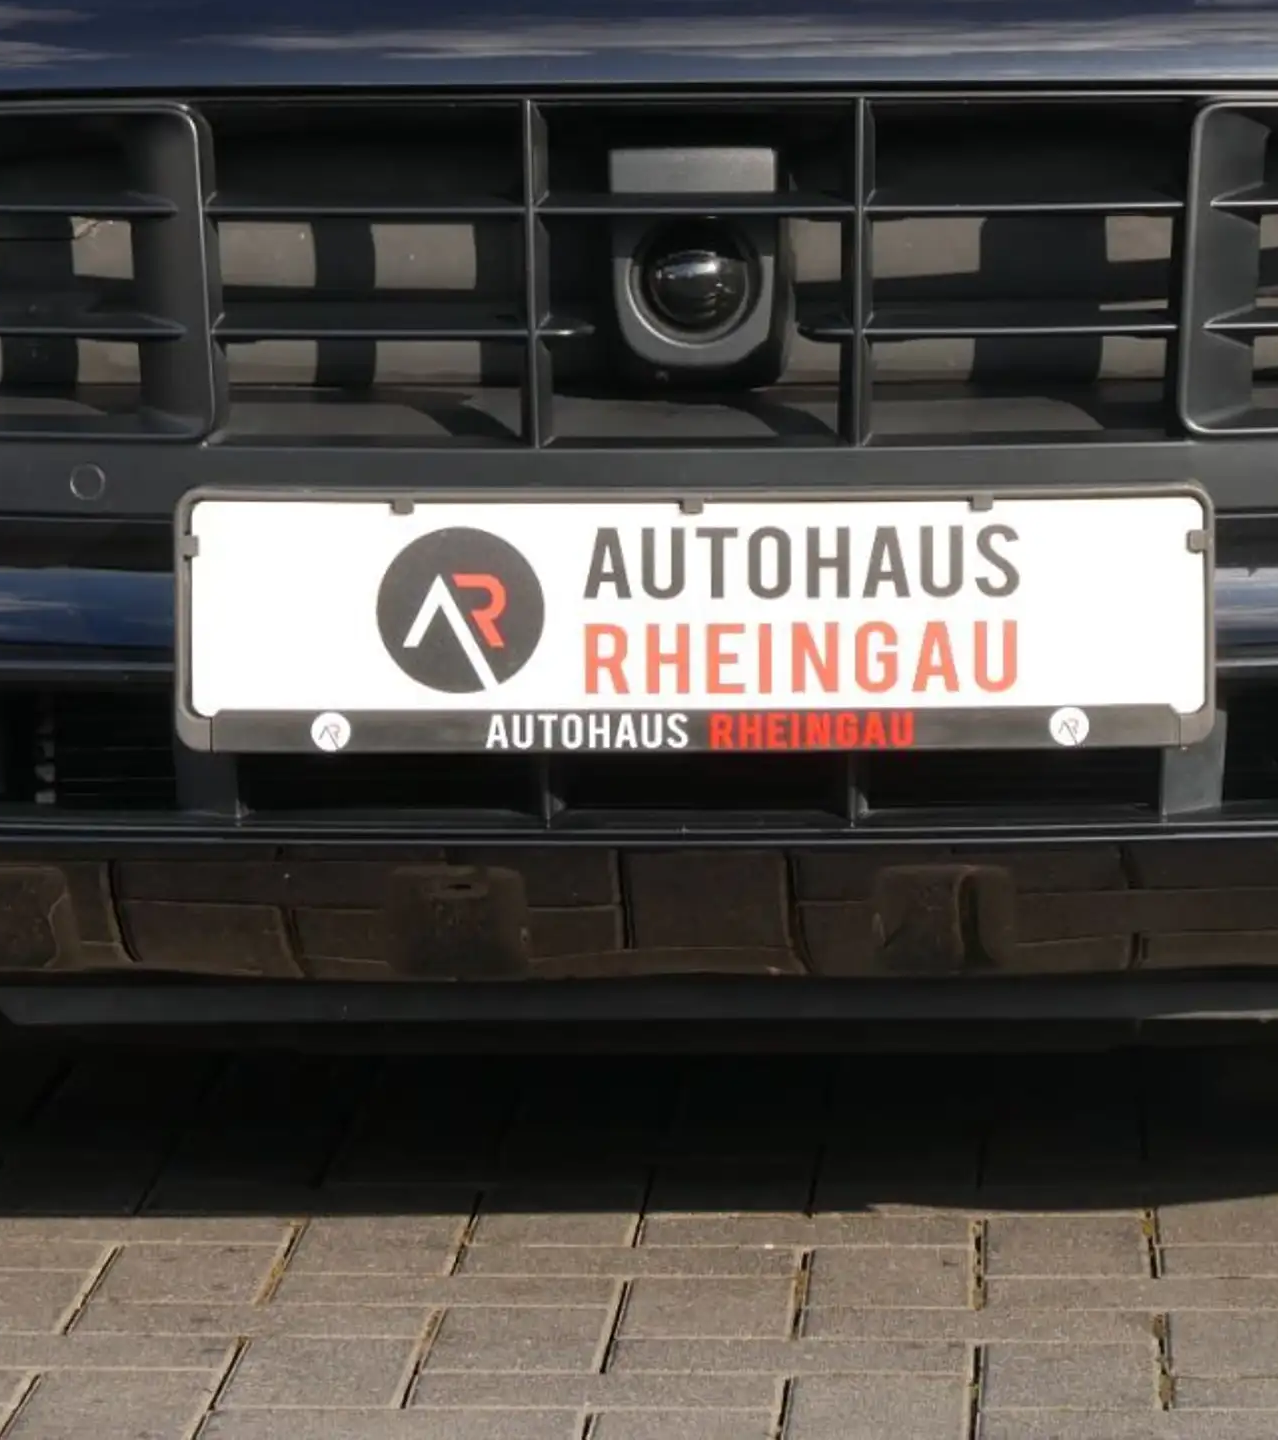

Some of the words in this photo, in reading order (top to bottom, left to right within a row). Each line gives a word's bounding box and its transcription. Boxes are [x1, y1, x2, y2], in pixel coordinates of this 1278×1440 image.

[582, 524, 1021, 600] AUTOHAUS
[583, 619, 1019, 695] RHEINGAU
[485, 712, 690, 750] AUTOHAUS
[709, 711, 915, 750] RHEINGAU
